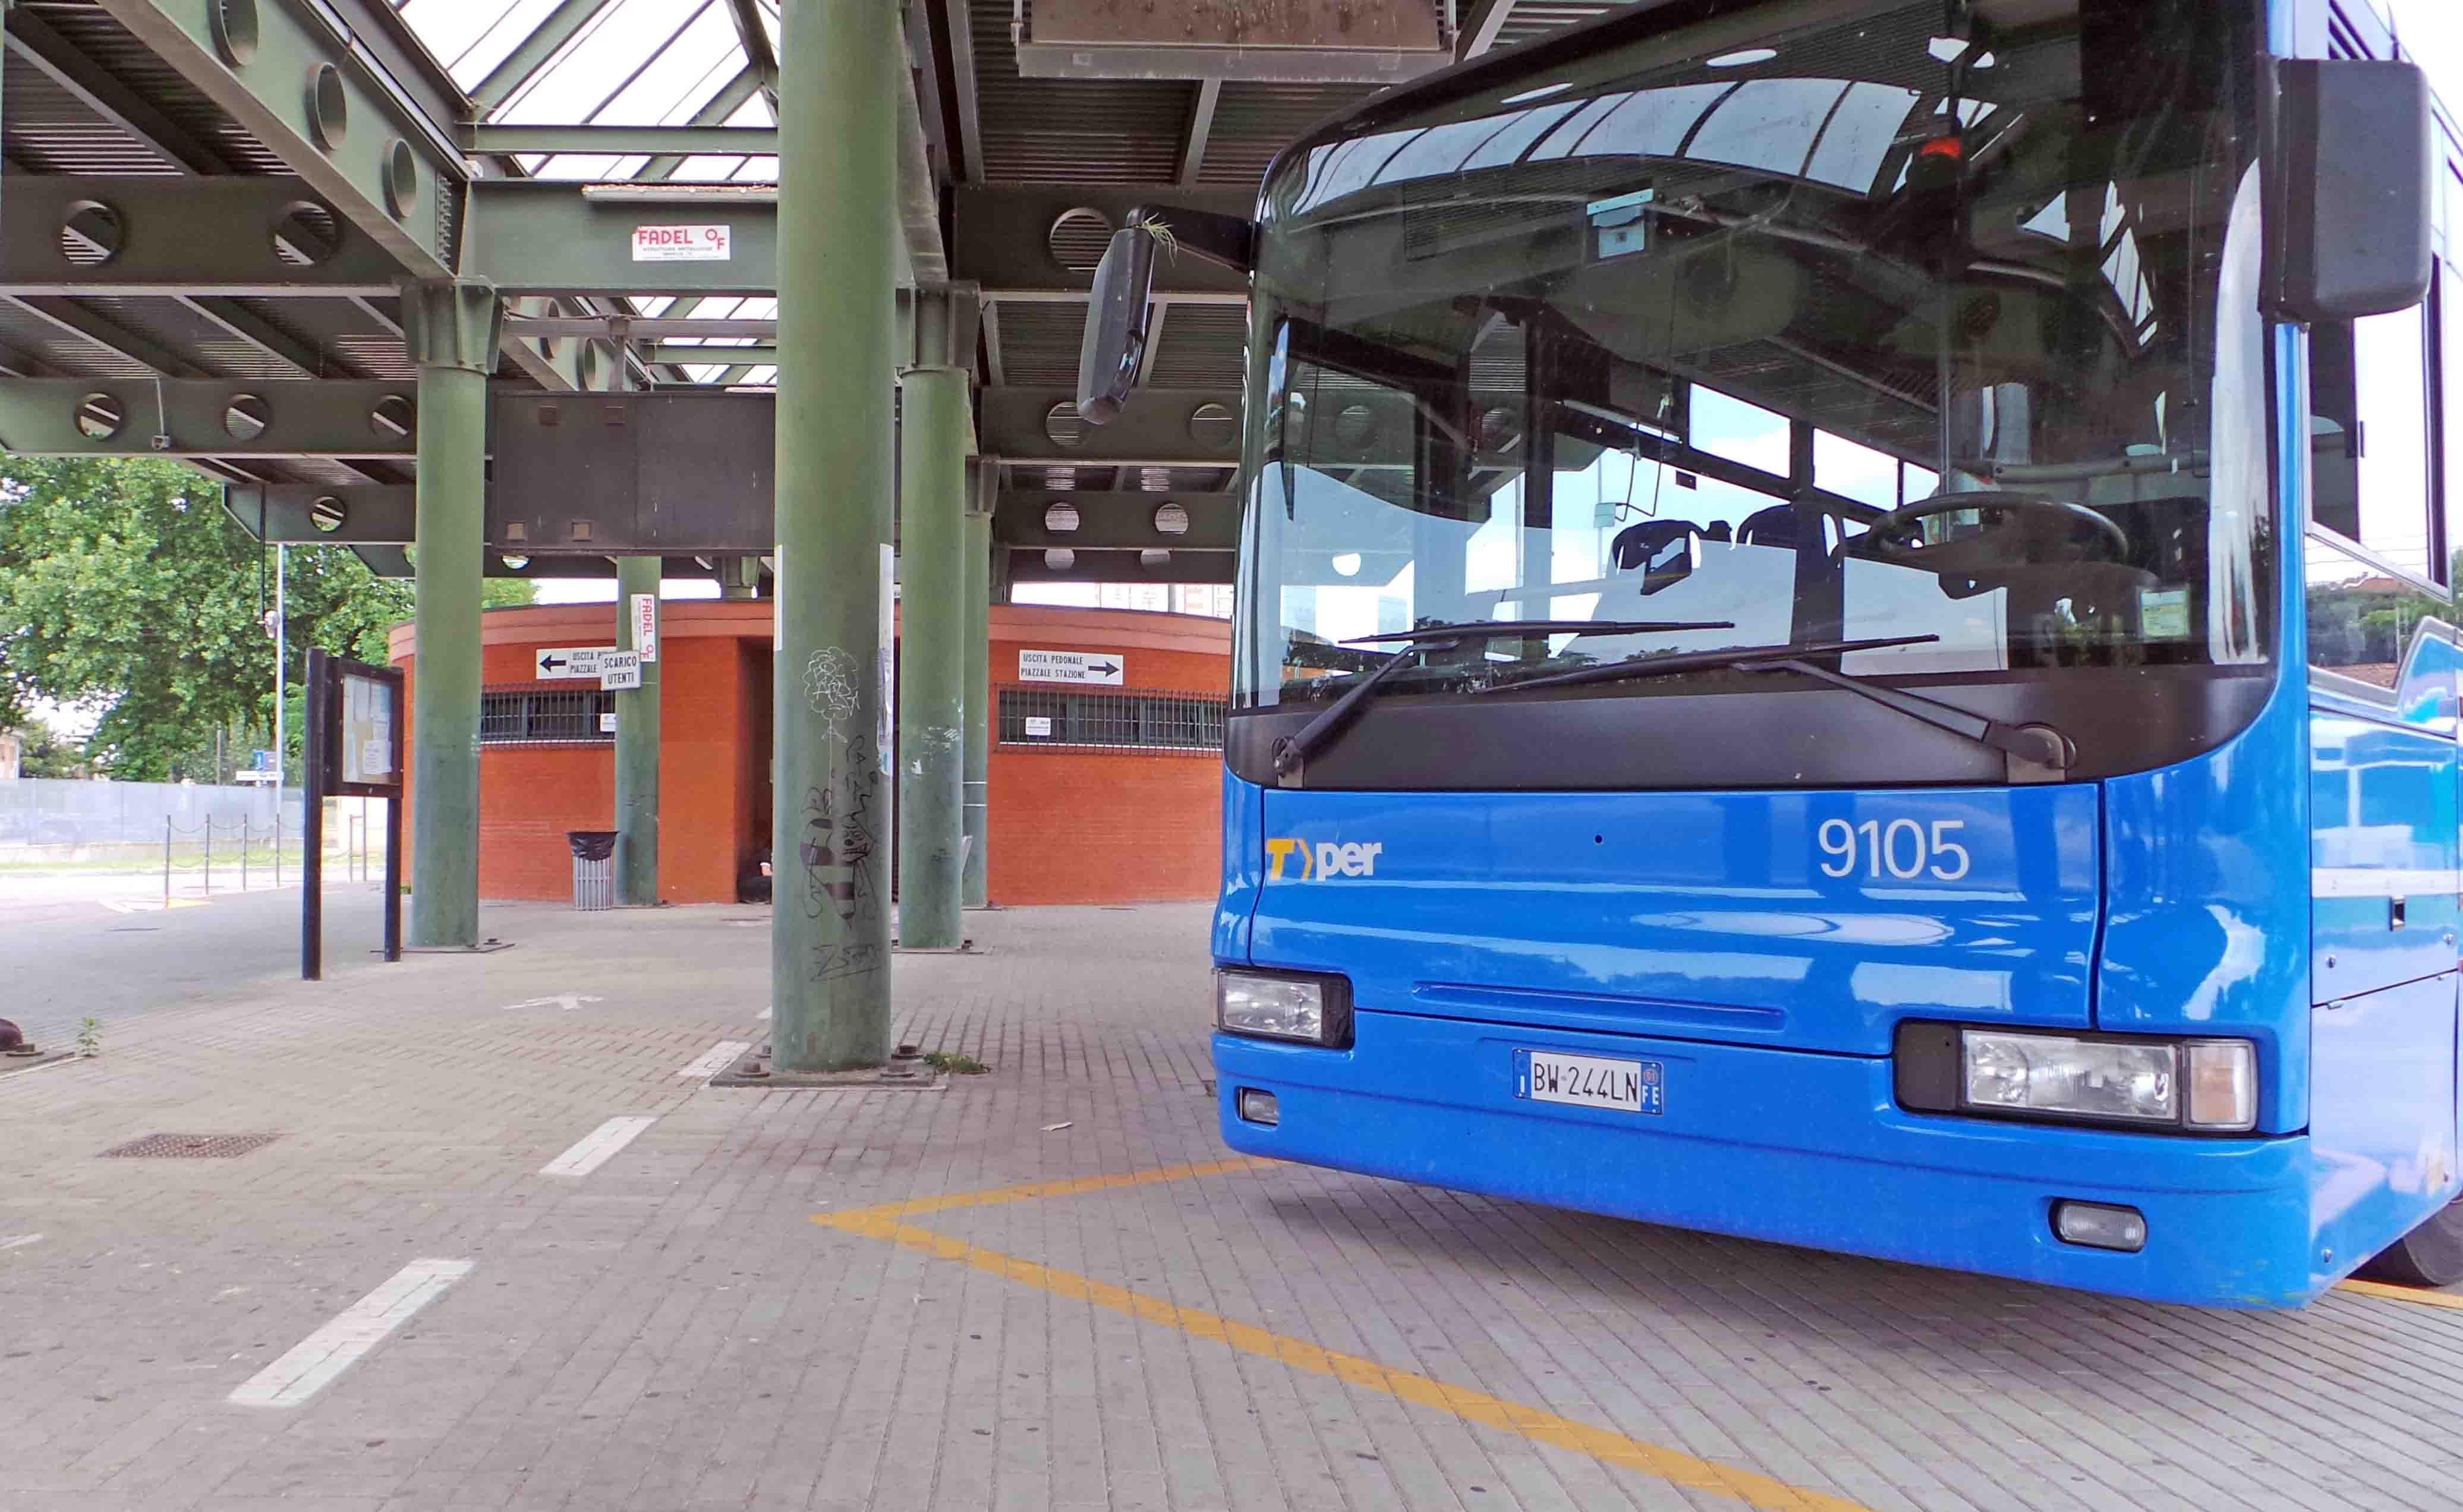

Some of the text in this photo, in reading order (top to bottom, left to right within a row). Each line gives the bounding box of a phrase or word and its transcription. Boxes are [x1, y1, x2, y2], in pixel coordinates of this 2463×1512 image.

[637, 229, 694, 245] FADEL
[642, 598, 653, 637] FADEL
[572, 651, 594, 661] USCITA
[1023, 653, 1084, 665] USCITA PEDONALE
[570, 664, 597, 673] PIAZZALE
[604, 656, 637, 669] SCARICO
[607, 672, 635, 684] UTENTI
[1021, 667, 1085, 679] PIAZZALE STAZIONE
[1819, 818, 1970, 880] 9105
